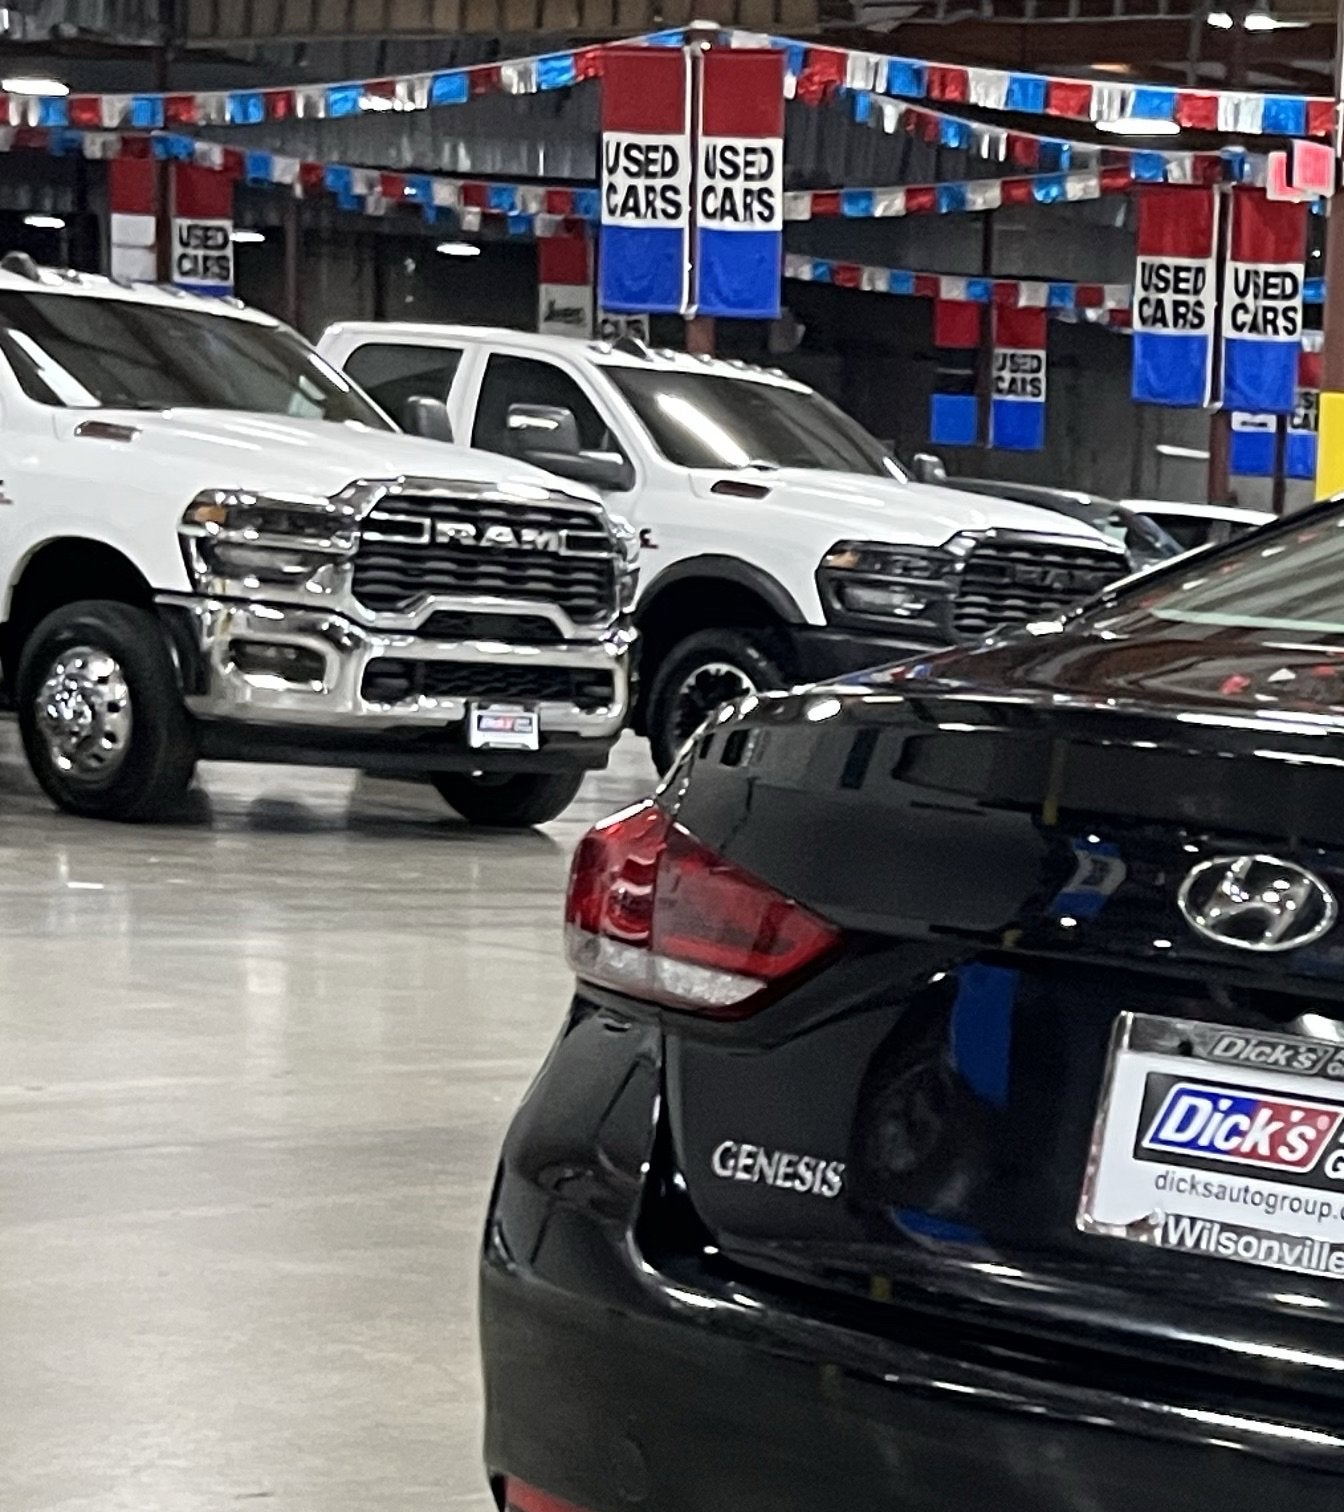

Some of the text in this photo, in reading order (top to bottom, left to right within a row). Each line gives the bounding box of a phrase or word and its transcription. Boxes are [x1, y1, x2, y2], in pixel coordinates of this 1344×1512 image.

[605, 141, 679, 179] USED
[704, 144, 774, 182] USED
[605, 182, 682, 220] CARS
[701, 185, 775, 223] CARS
[1140, 262, 1206, 296] USED
[1234, 267, 1299, 301] USED
[1138, 296, 1206, 330] CARS
[1231, 302, 1298, 336] CARS
[436, 522, 558, 552] RAM
[1213, 1036, 1318, 1070] Dick's
[1158, 1095, 1317, 1162] Dick's
[711, 1140, 846, 1198] GENESIS
